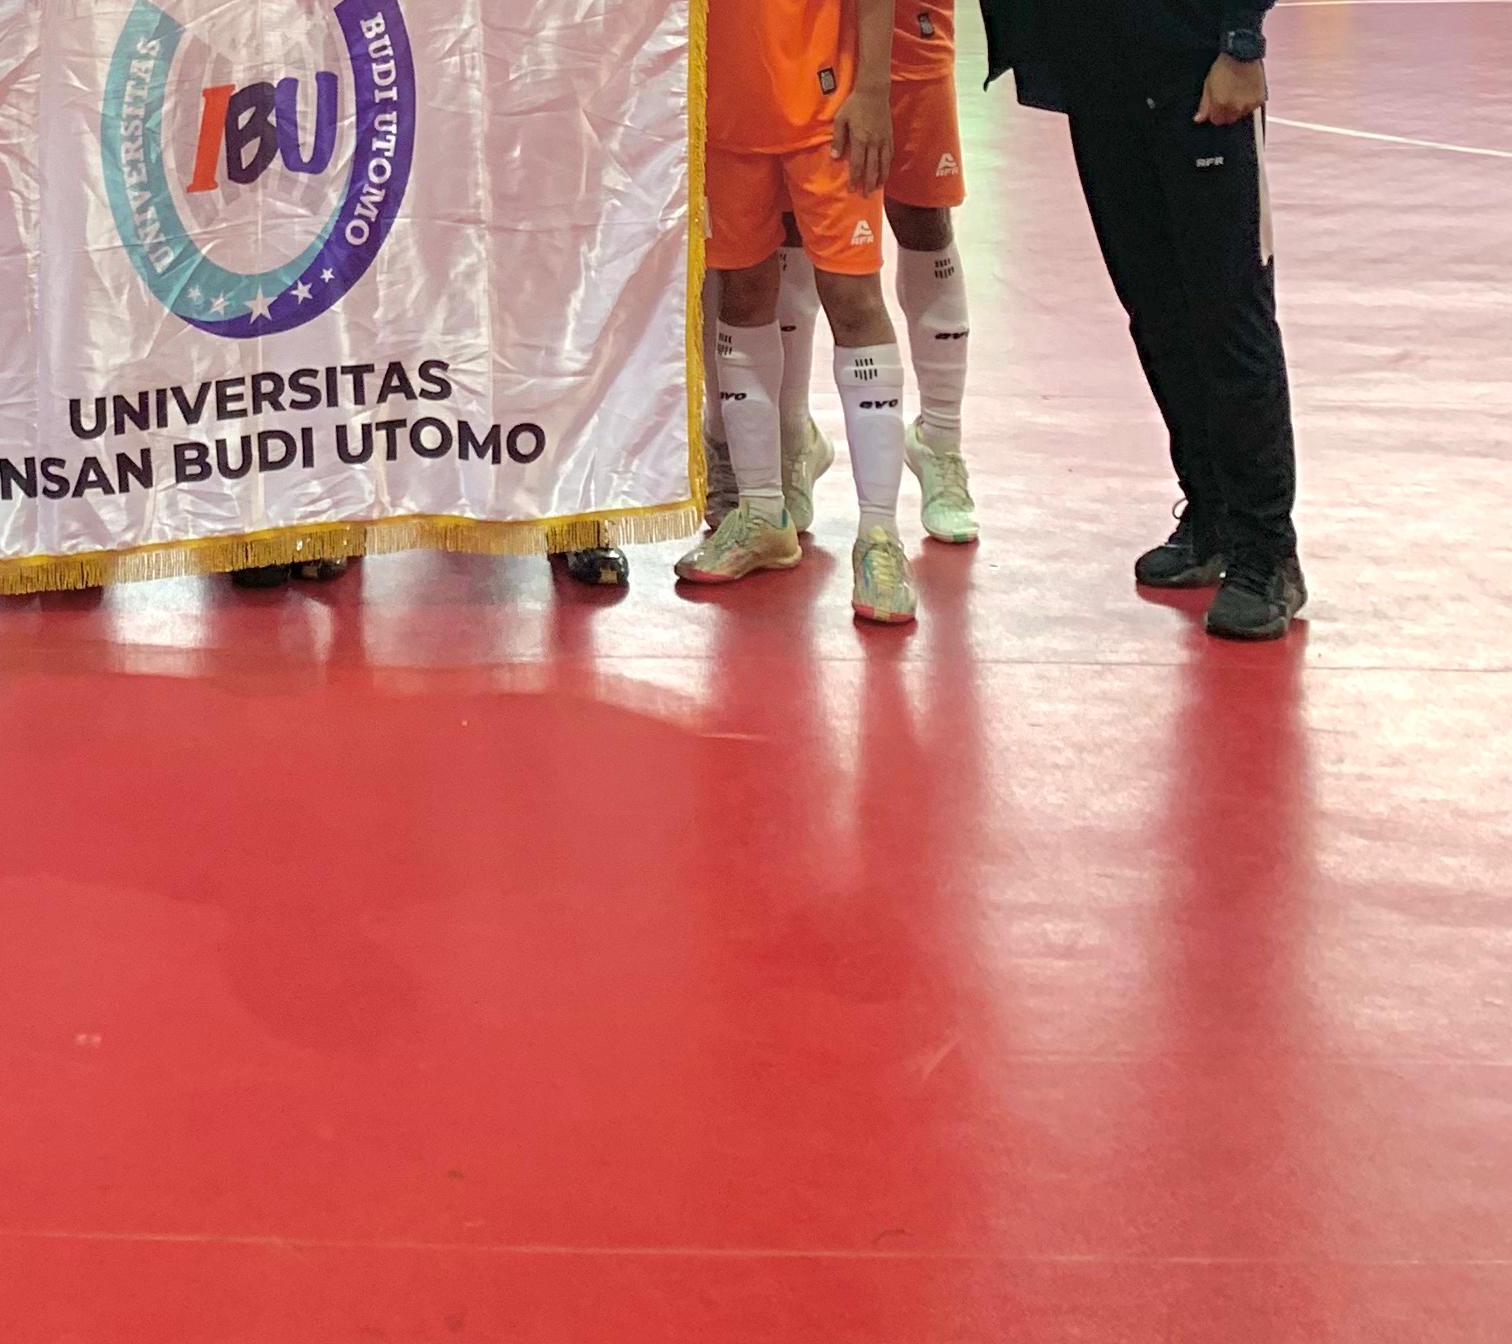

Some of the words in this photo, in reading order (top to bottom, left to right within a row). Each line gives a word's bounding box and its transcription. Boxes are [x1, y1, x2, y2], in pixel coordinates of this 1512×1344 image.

[359, 11, 398, 104] BUDI
[120, 36, 176, 274] UNIVERSITAS
[185, 70, 339, 194] IBU
[344, 110, 398, 246] UTOMO
[68, 359, 453, 440] UNIVERSITAS
[172, 426, 315, 484] BUDI
[334, 416, 547, 466] UTOMO
